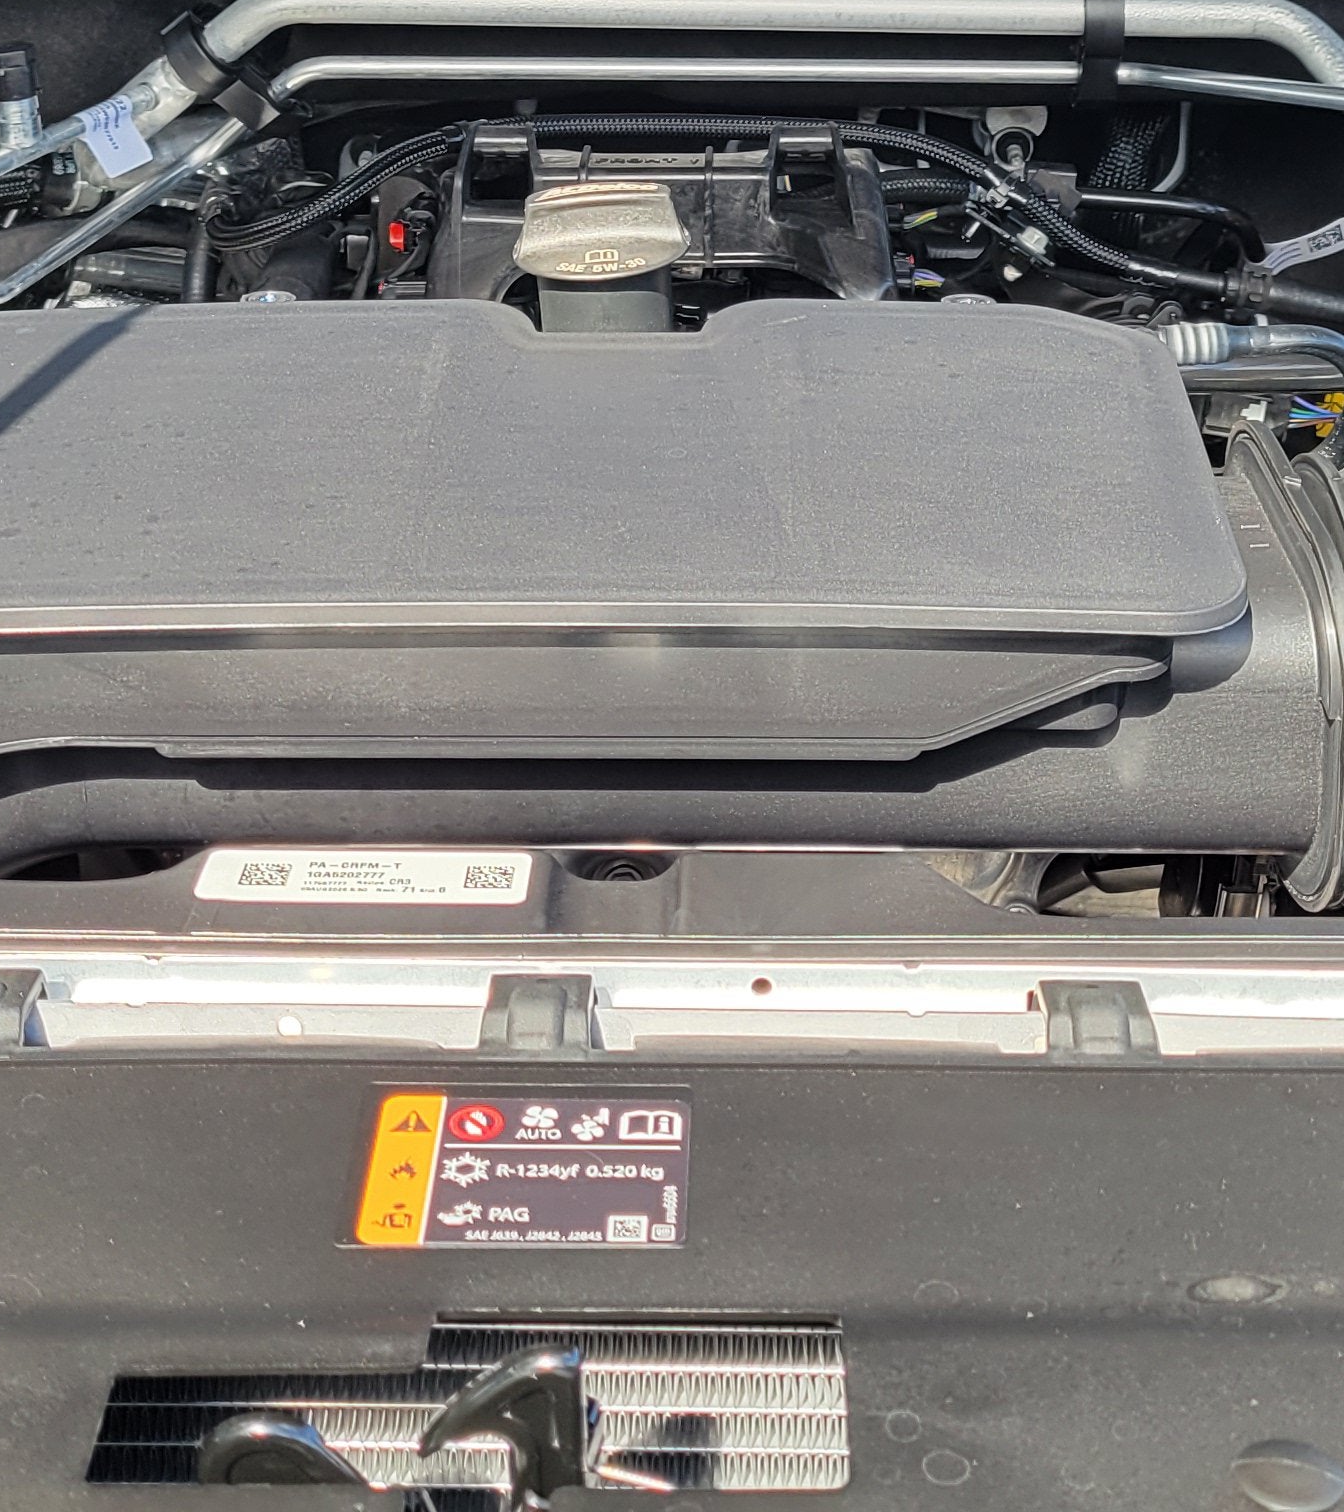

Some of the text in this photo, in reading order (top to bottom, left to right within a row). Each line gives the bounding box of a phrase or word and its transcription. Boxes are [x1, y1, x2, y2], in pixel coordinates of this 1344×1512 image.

[556, 257, 646, 273] SAE 5W-30
[515, 1127, 563, 1140] AUTO
[495, 1163, 665, 1181] R-1234yf 0.520 kg
[488, 1206, 531, 1223] PAG
[464, 1229, 489, 1241] SAE
